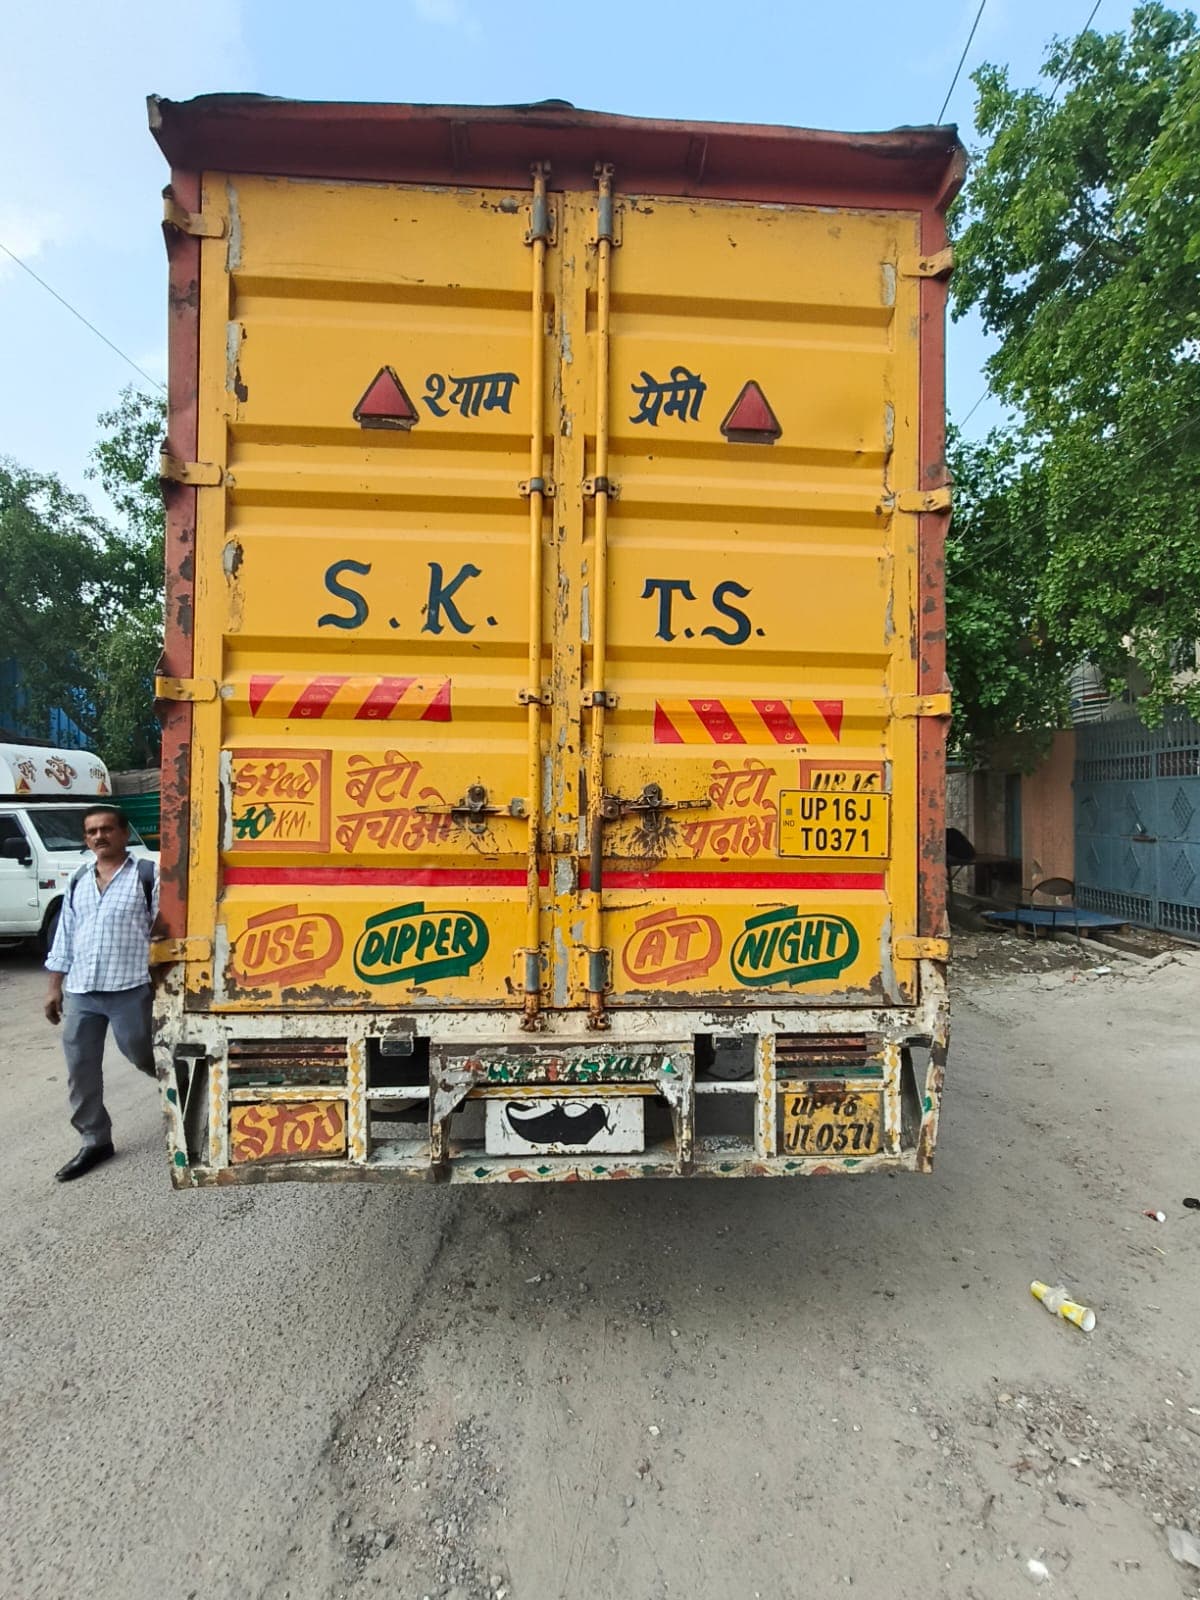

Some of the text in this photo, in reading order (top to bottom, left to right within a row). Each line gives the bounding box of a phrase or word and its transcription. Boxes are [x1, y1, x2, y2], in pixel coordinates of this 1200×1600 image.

[628, 366, 707, 426] प्रेमी
[345, 750, 423, 807] बेटी
[708, 758, 777, 810] बेटी
[801, 827, 870, 852] T0371
[241, 917, 845, 970] USE DIPPER AT NIGHT
